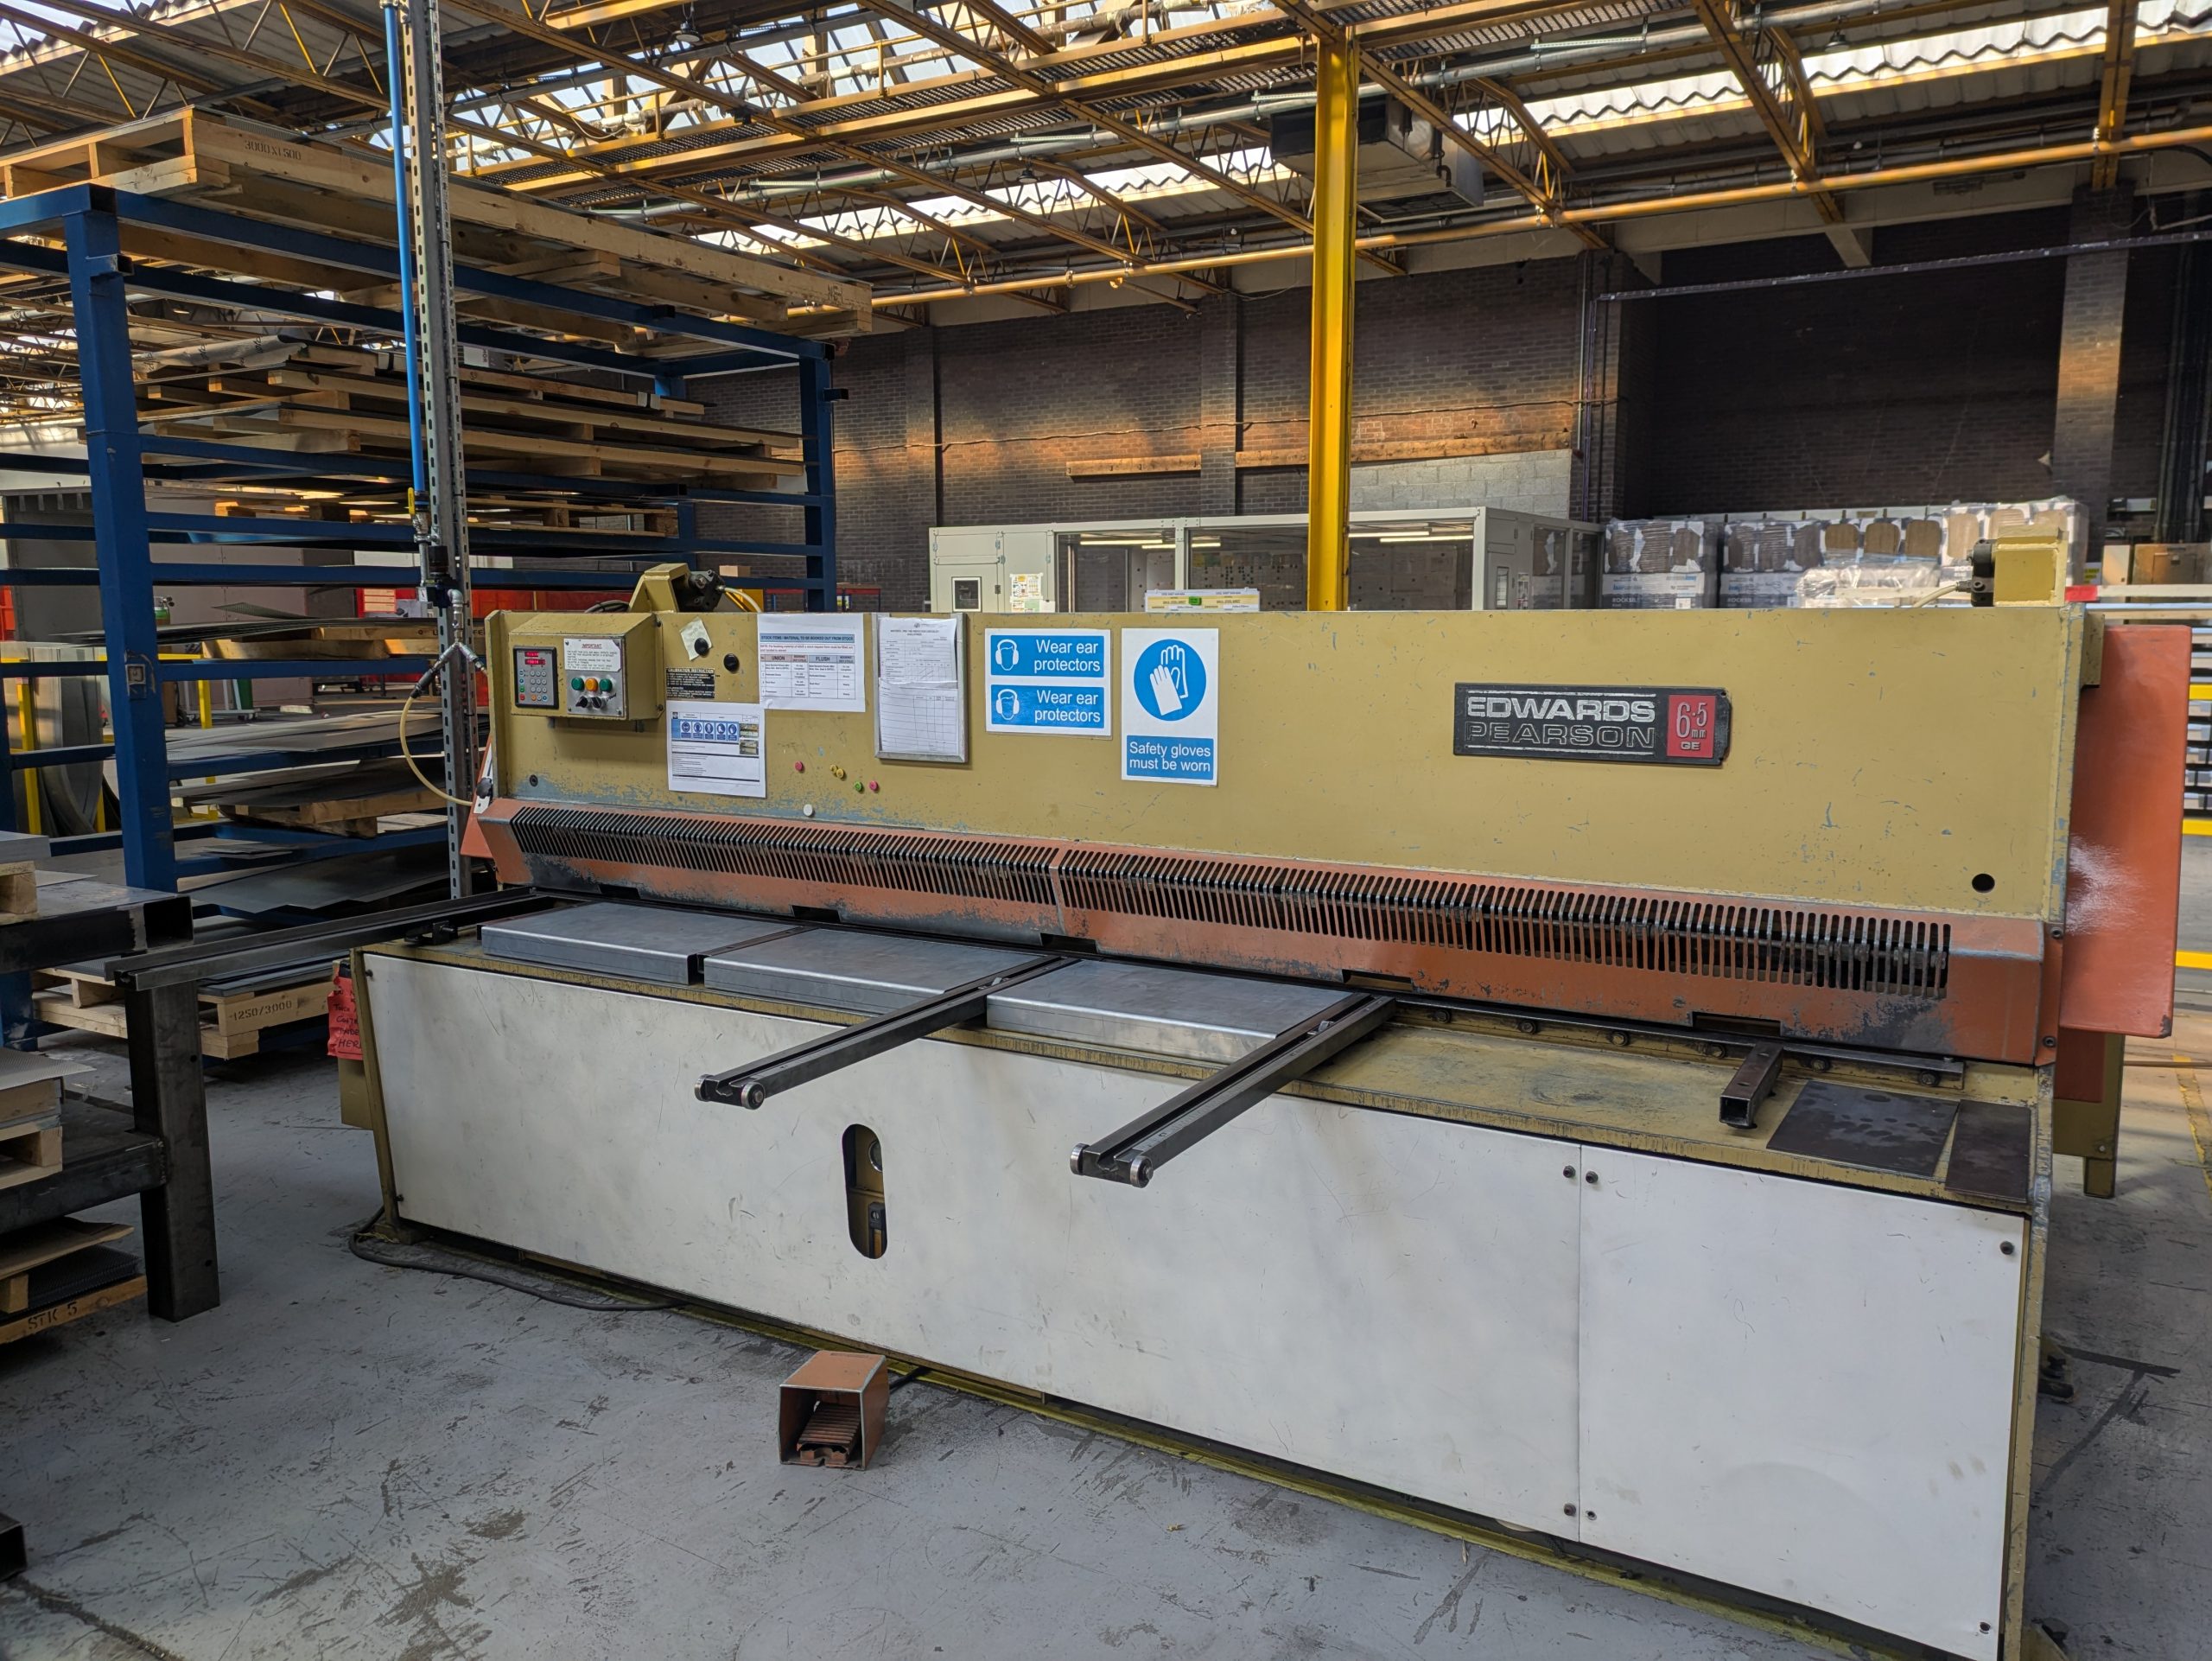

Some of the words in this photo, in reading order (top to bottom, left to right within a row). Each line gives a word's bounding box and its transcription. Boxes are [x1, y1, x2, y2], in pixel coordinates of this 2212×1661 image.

[1036, 640, 1071, 654] Wear
[1077, 641, 1098, 654] ear
[1034, 658, 1101, 673] protectors
[1037, 690, 1072, 704] Wear
[1076, 692, 1098, 705] ear
[1034, 708, 1101, 723] protectors
[1467, 697, 1656, 722] EDWARDS
[1465, 721, 1655, 748] PEARSON
[1129, 741, 1167, 758] Safety
[1171, 744, 1211, 759] gloves
[1681, 741, 1700, 750] GE
[1129, 758, 1159, 769] must
[1162, 758, 1177, 771] be
[1180, 760, 1211, 773] worn
[233, 1000, 292, 1021] 1250/3000
